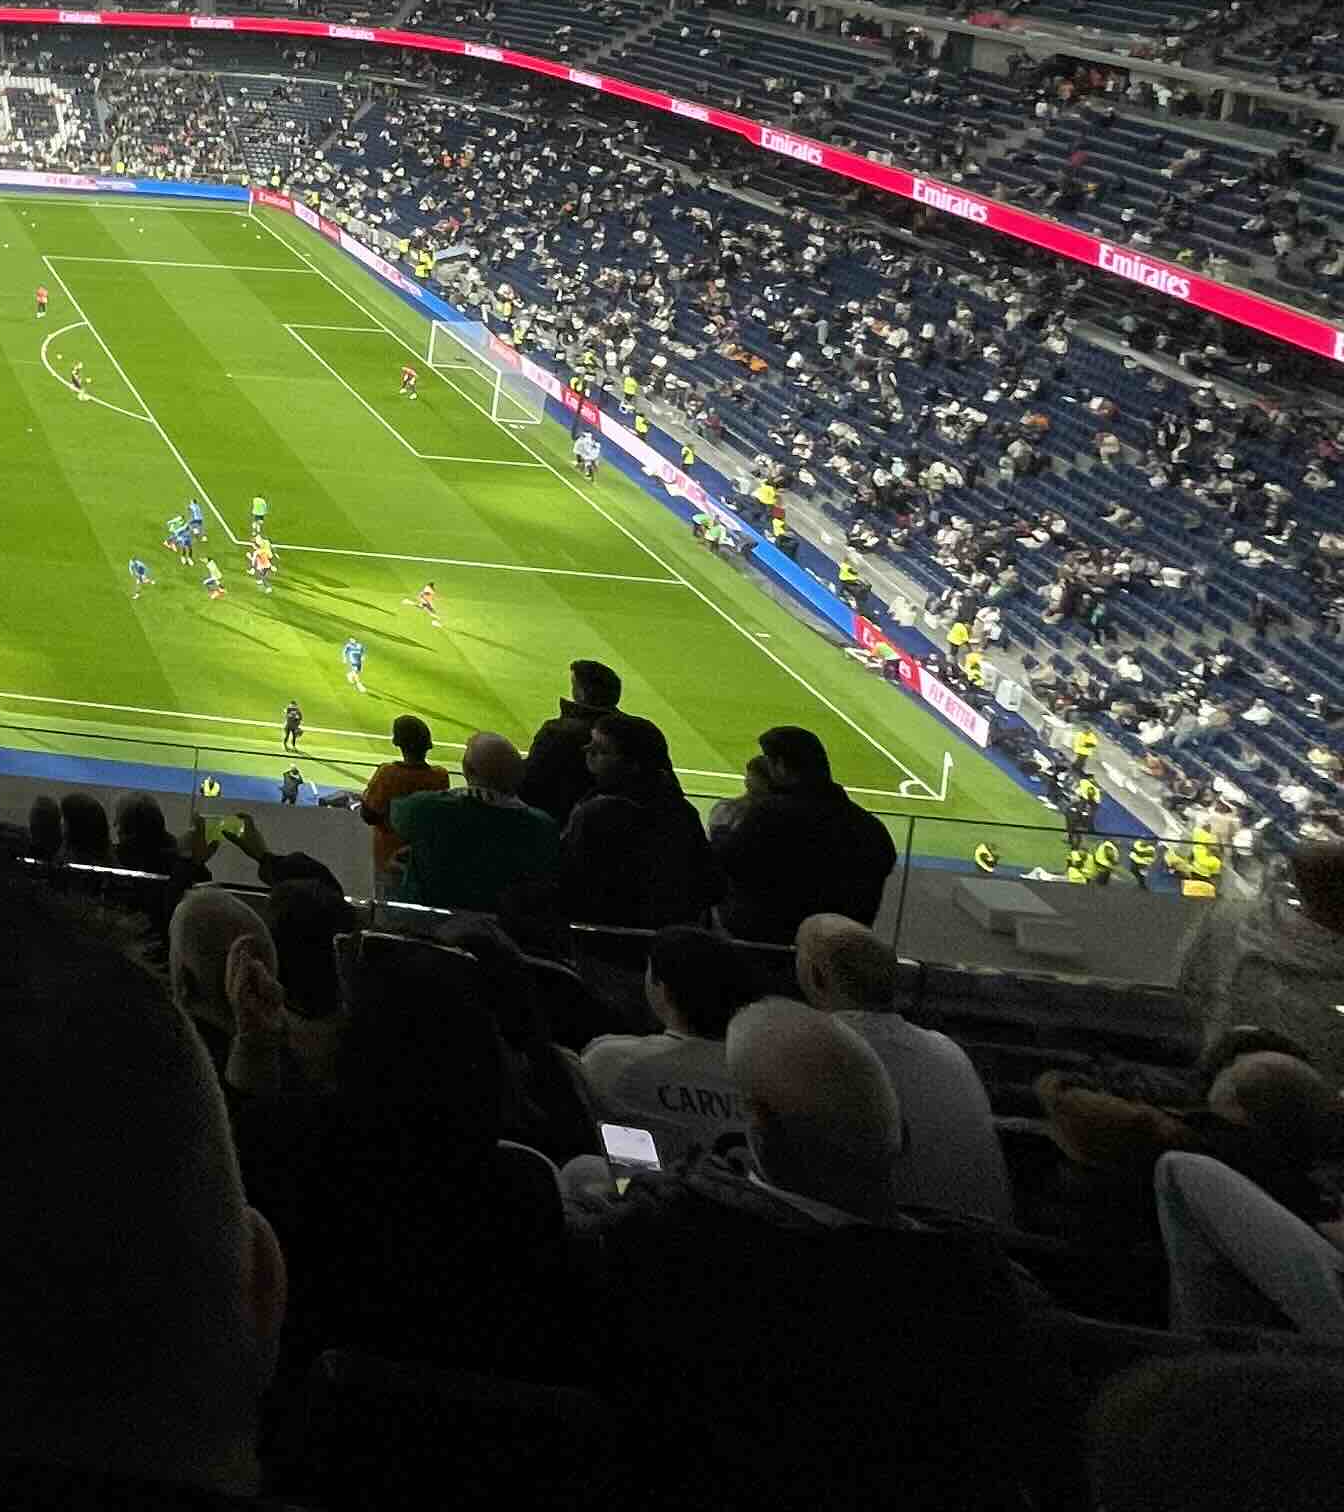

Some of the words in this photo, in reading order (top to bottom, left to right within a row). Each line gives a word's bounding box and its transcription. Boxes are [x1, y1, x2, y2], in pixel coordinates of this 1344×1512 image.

[760, 127, 823, 167] Emirates
[912, 178, 988, 224] Emirates
[1097, 242, 1191, 300] Emirates
